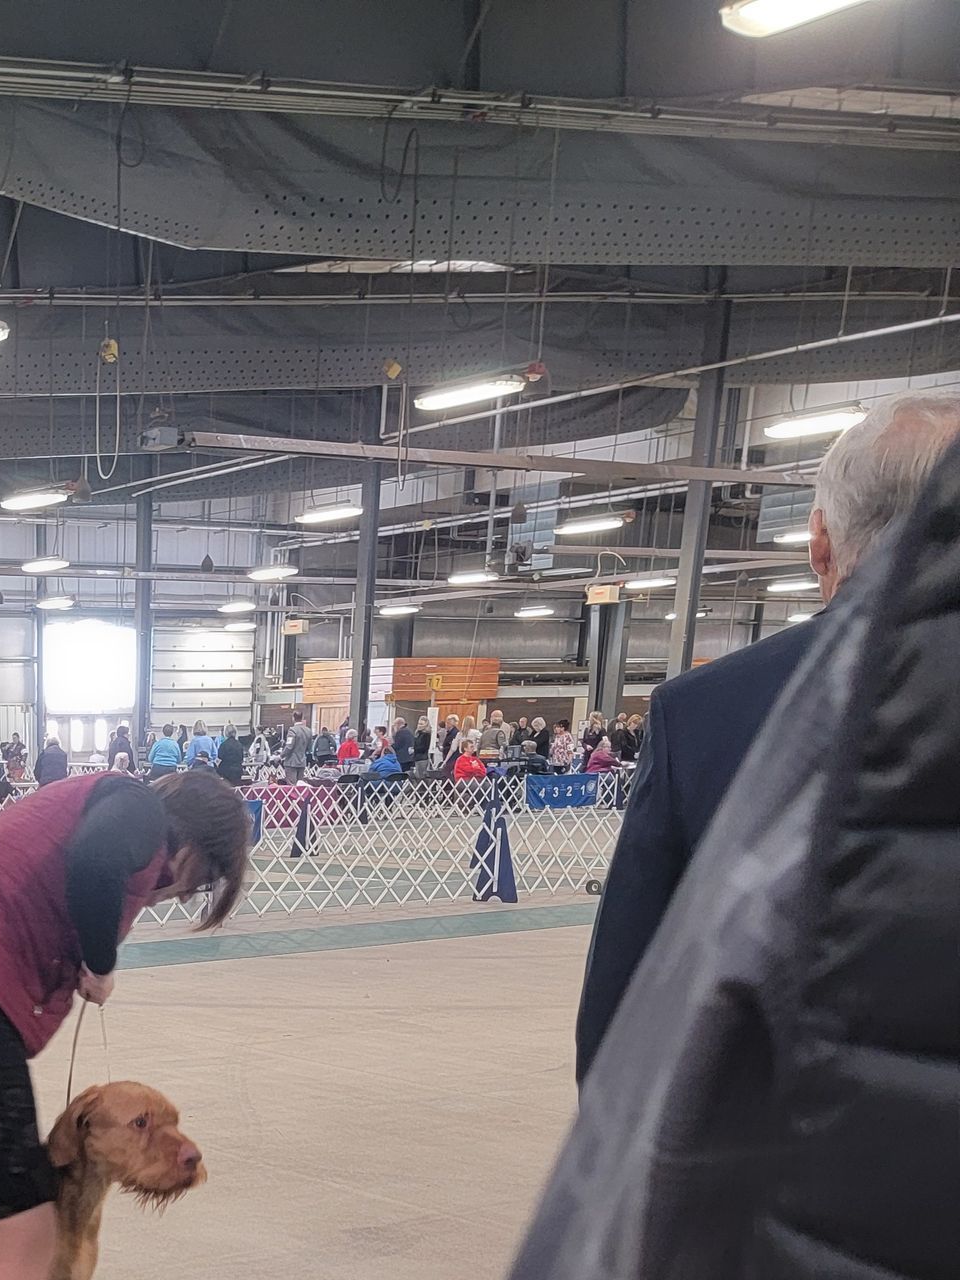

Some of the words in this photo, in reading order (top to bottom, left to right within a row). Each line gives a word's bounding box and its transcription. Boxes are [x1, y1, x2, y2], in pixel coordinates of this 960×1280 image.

[538, 787, 545, 798] 4
[552, 786, 559, 798] 3
[566, 785, 573, 797] 2
[580, 784, 586, 796] 1
